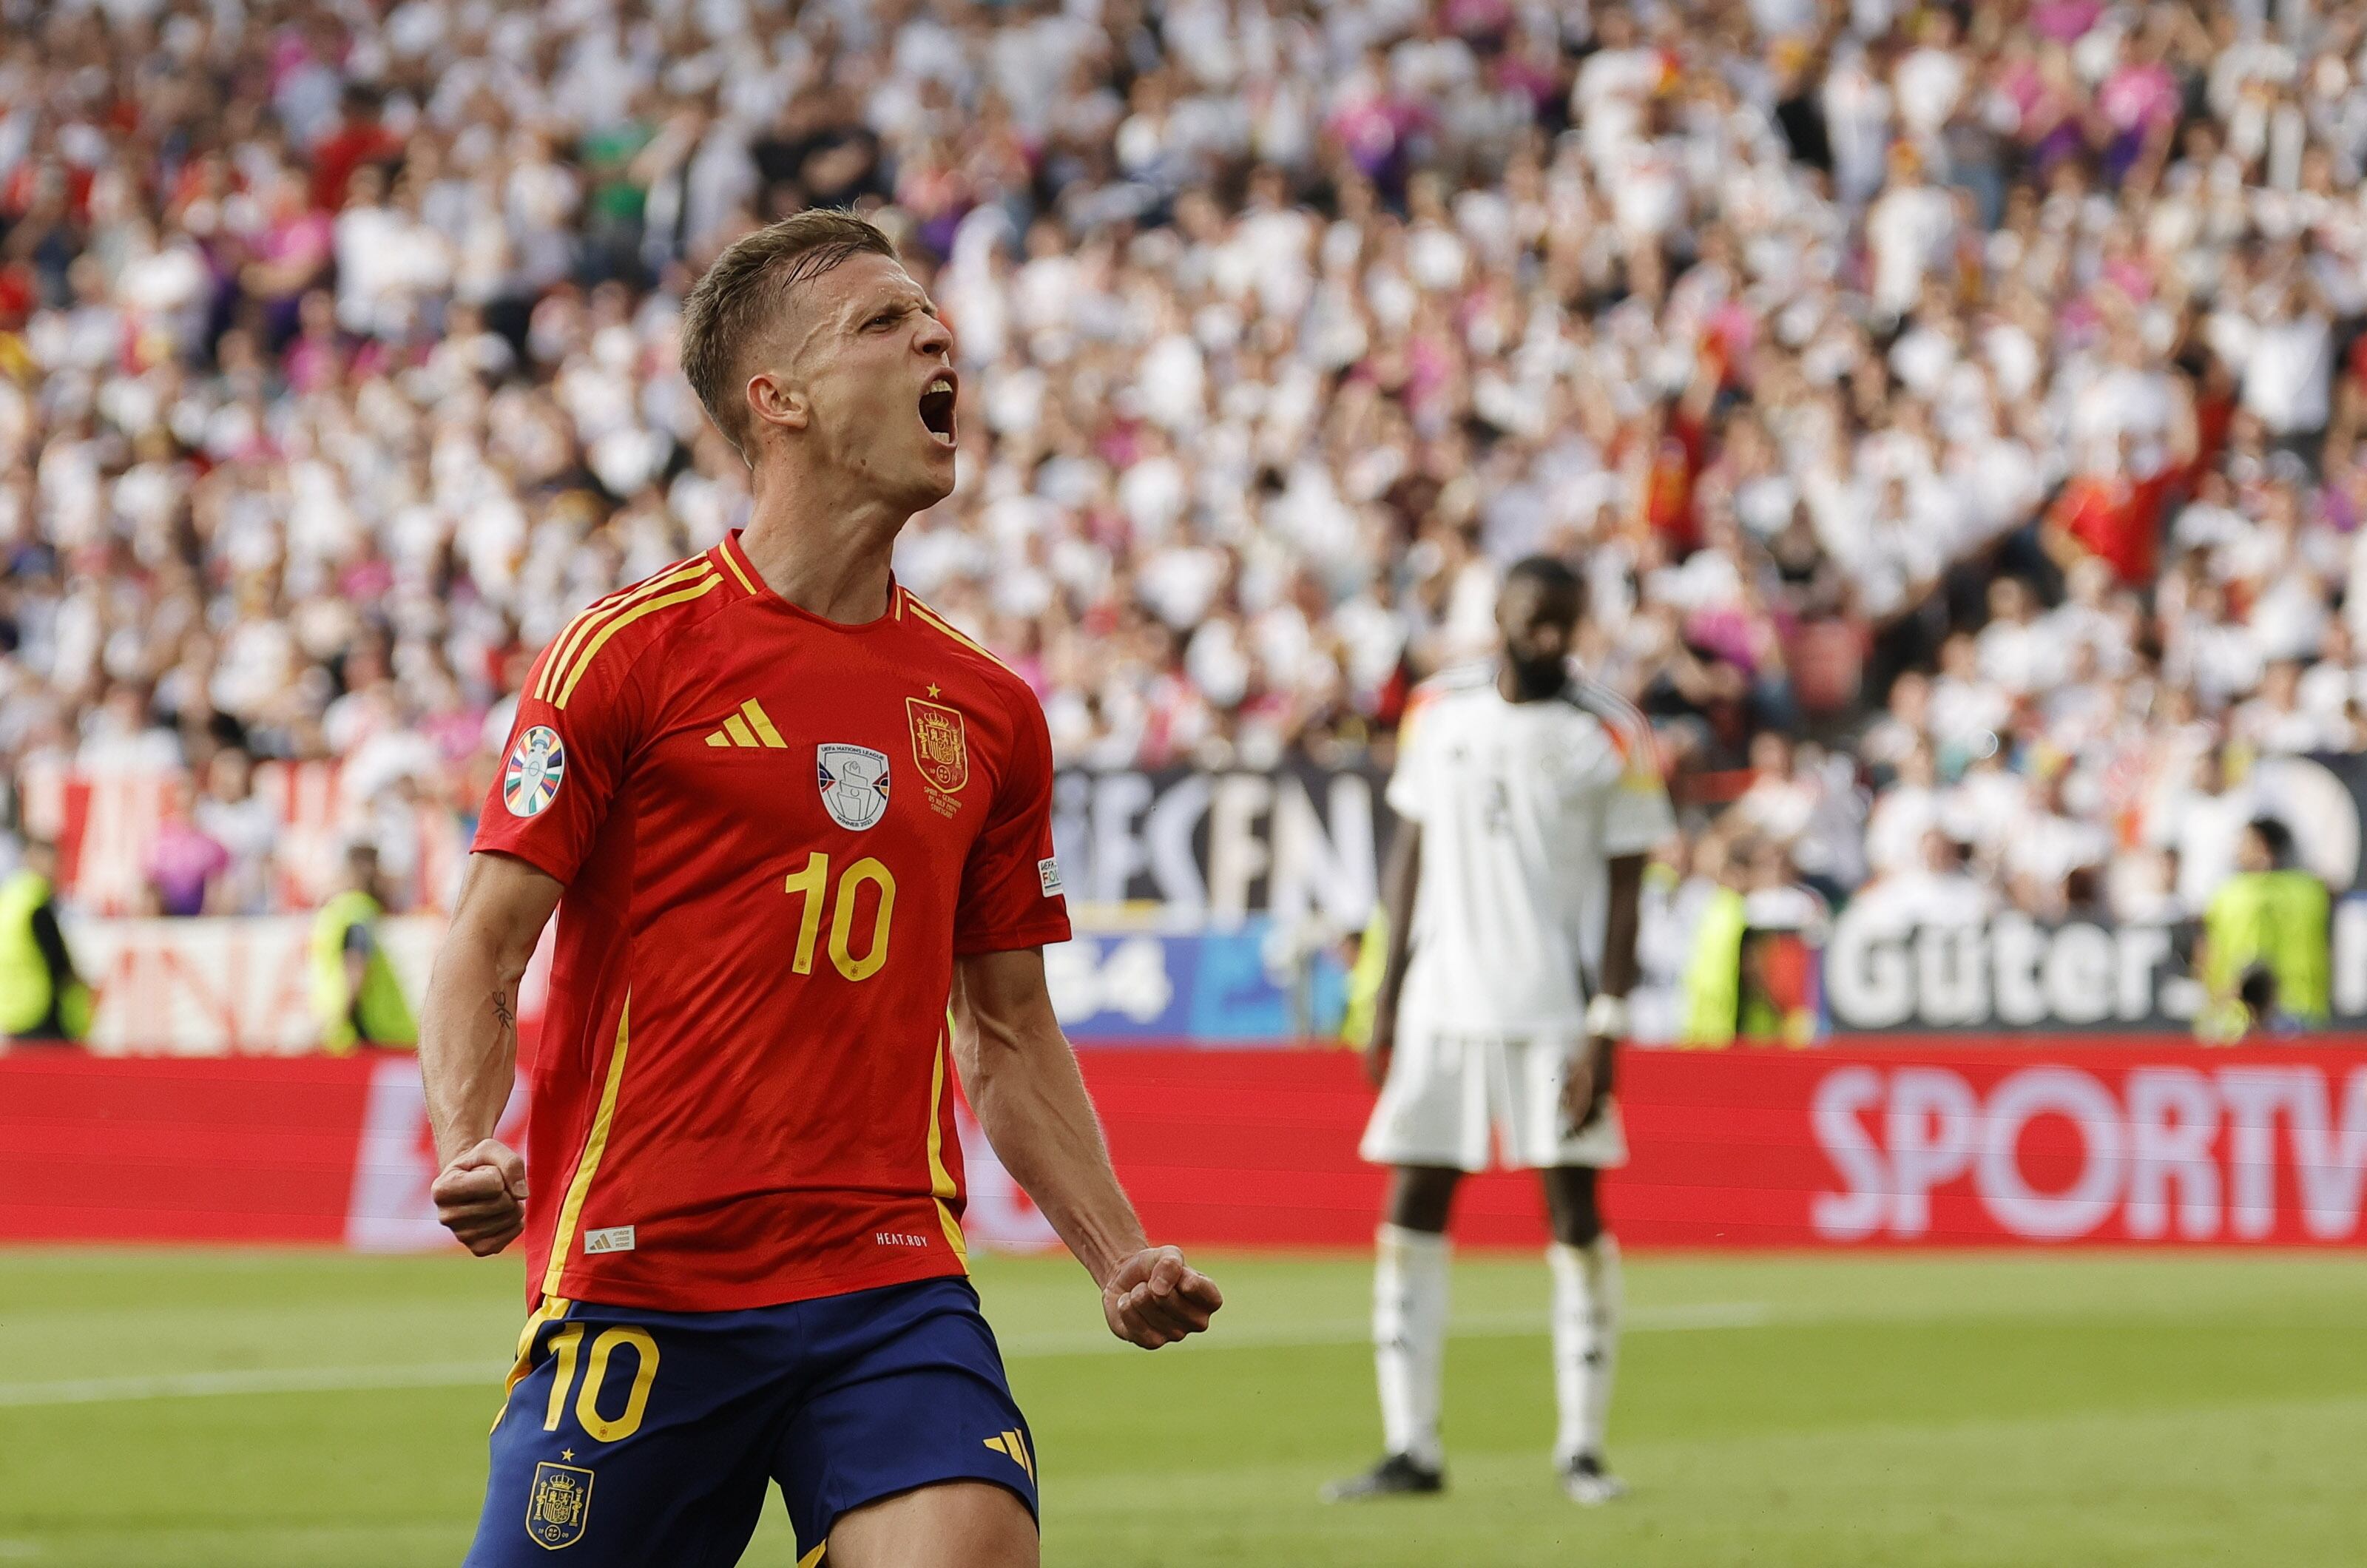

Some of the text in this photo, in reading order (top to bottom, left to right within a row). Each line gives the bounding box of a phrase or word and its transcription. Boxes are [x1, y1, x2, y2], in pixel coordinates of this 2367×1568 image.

[862, 749, 884, 760] LEAGUE
[786, 851, 897, 982] 10
[543, 1322, 661, 1442] 10
